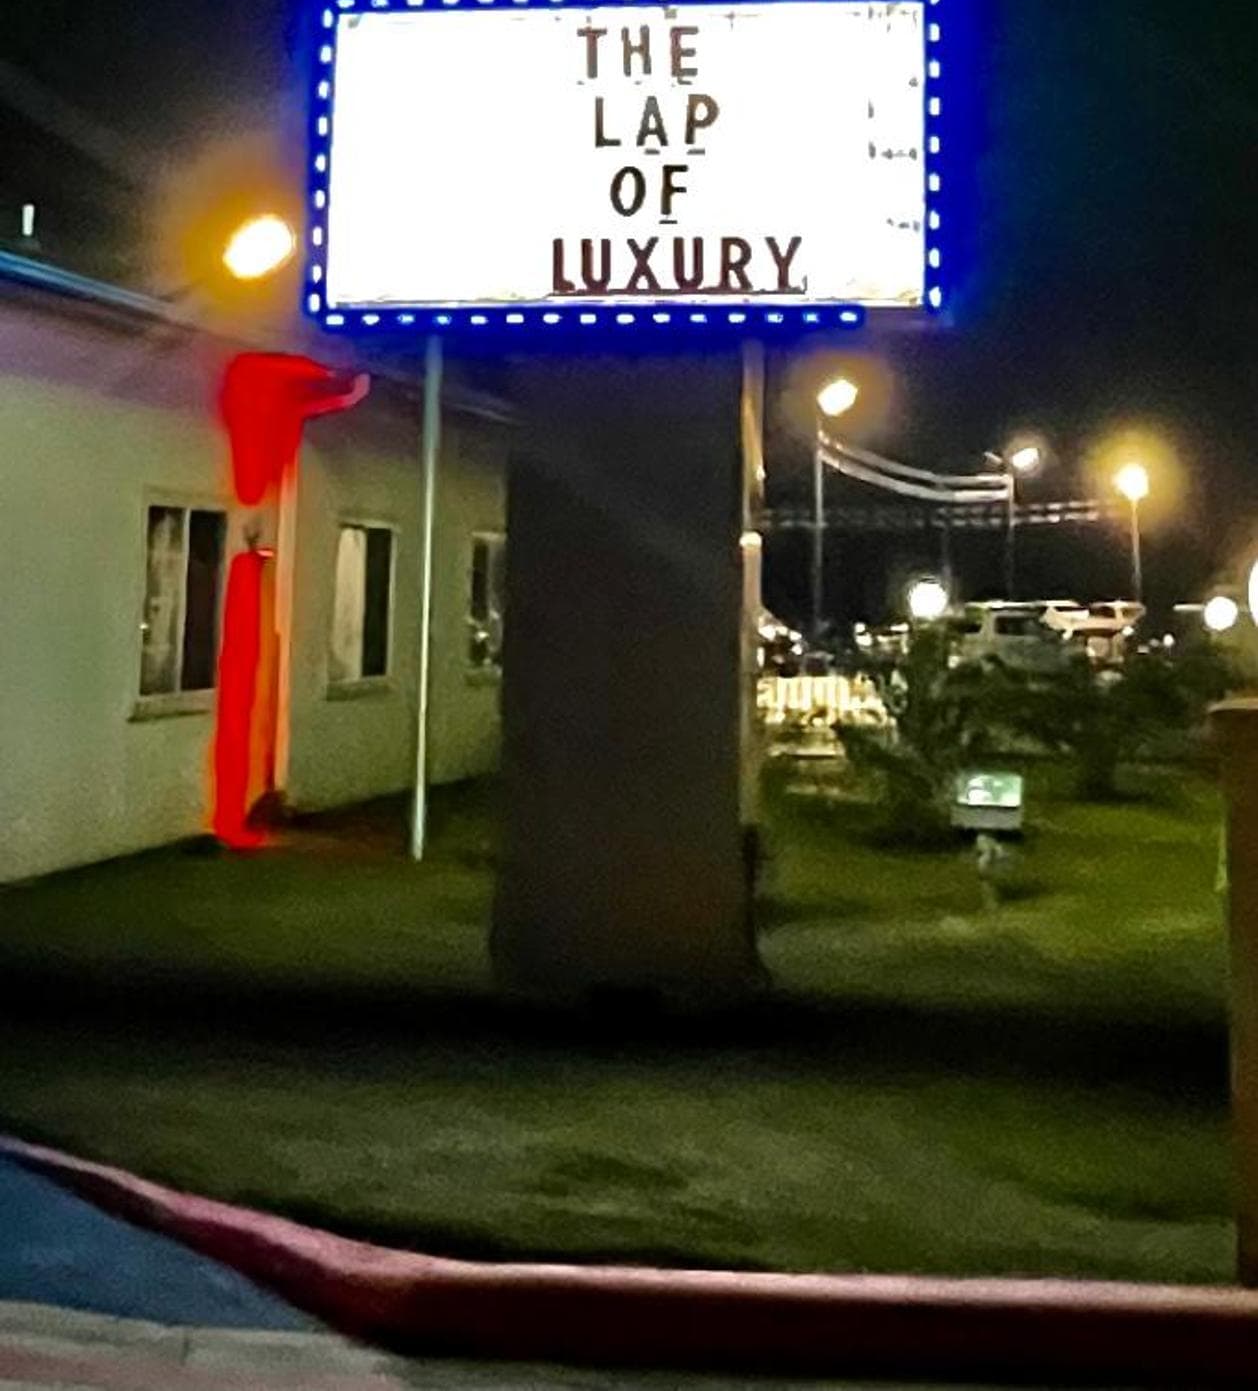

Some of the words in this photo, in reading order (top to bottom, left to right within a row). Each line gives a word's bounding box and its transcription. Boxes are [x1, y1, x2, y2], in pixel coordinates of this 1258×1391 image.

[576, 25, 701, 81] THE
[594, 93, 721, 149] LAP
[608, 164, 690, 218] OF
[552, 236, 803, 292] LUXURY
